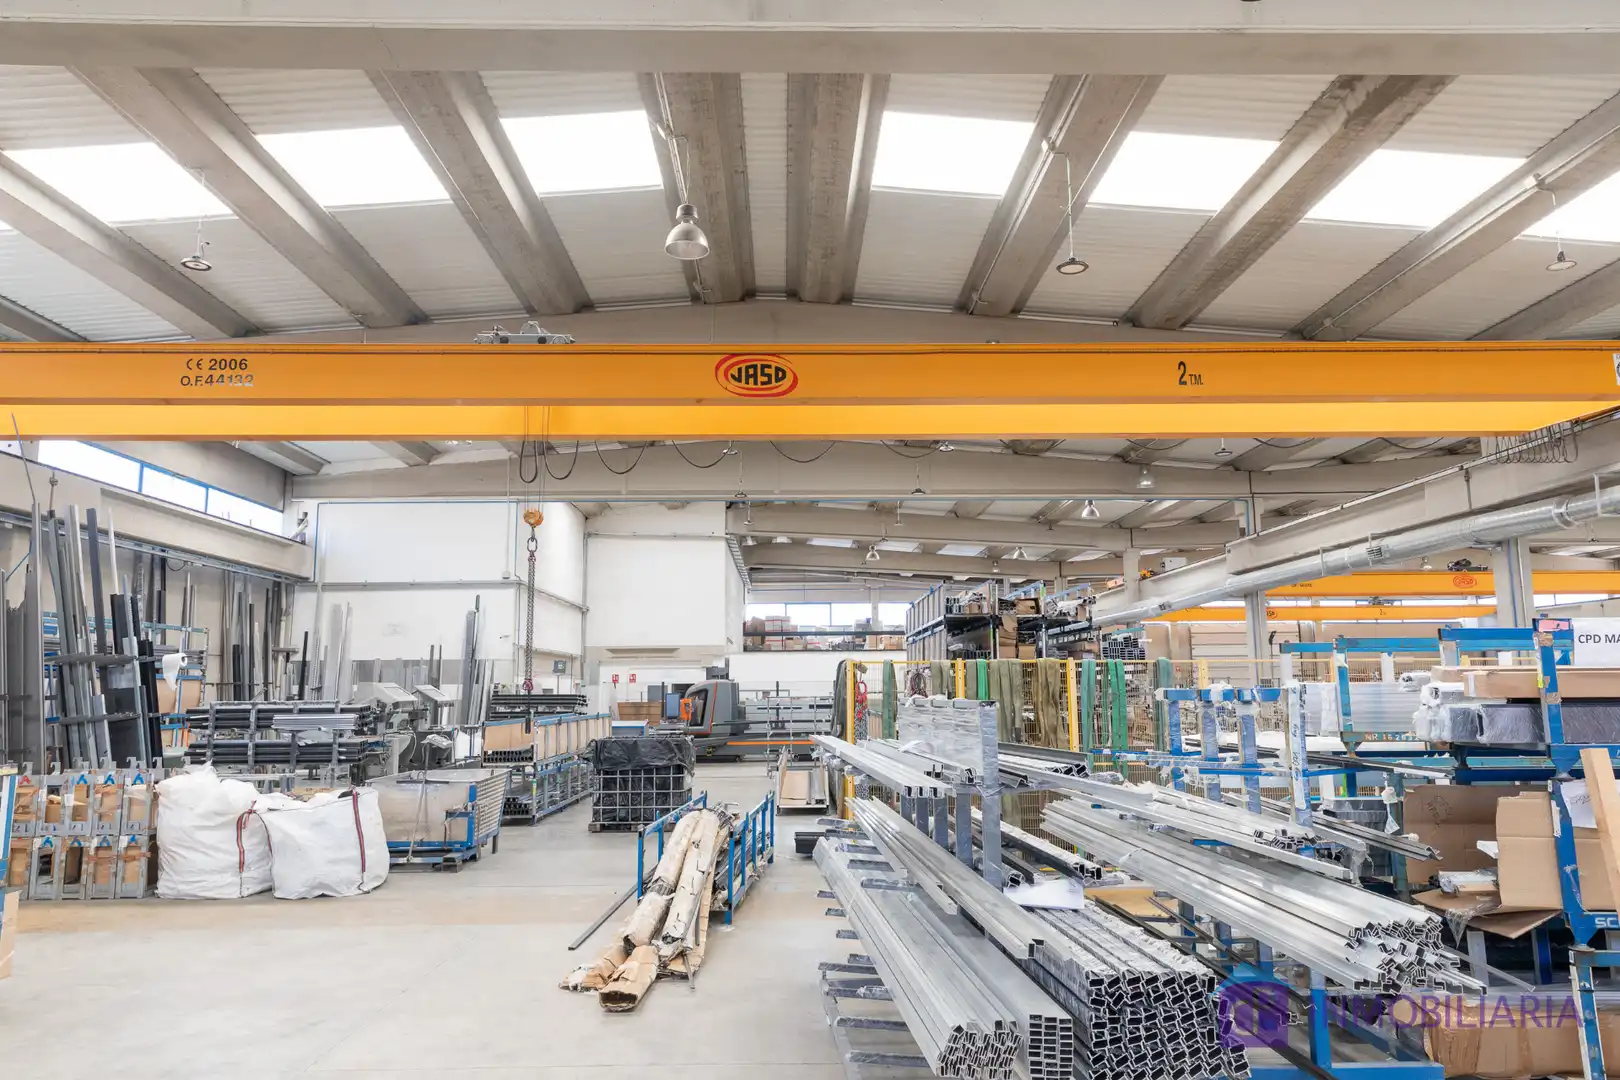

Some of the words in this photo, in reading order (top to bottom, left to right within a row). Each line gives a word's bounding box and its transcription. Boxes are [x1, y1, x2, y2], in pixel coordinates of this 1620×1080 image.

[208, 358, 248, 370] 2006
[1177, 360, 1187, 385] 2
[730, 363, 787, 386] JASO
[1578, 634, 1602, 644] CPD
